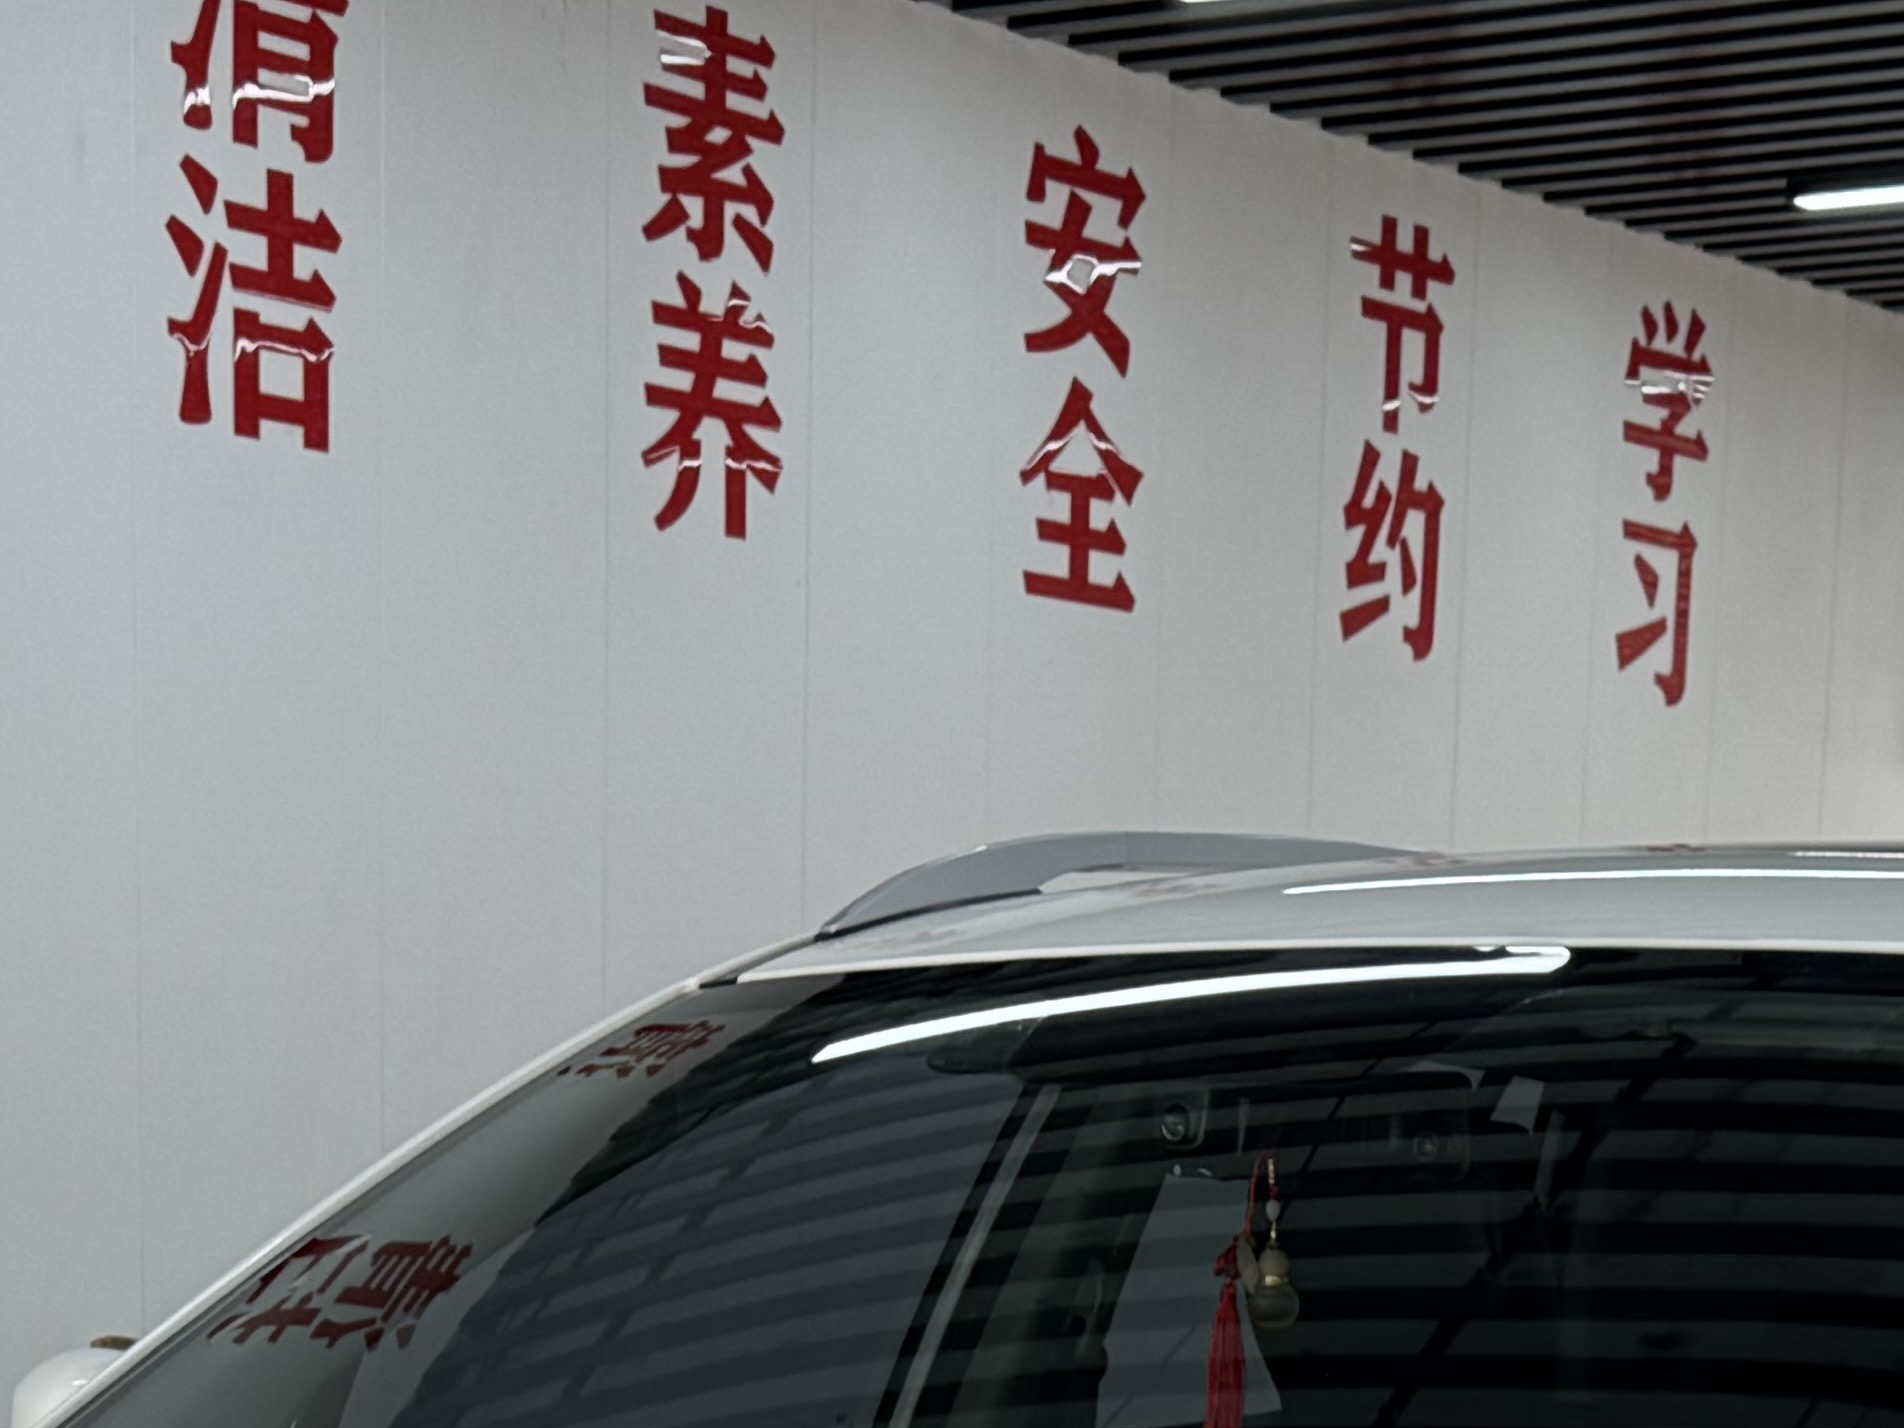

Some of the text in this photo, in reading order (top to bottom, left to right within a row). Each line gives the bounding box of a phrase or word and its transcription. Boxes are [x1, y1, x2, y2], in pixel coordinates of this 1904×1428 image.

[641, 5, 786, 541] 素养
[1019, 124, 1146, 613] 安全
[1339, 213, 1456, 662] 节约
[1615, 300, 1715, 708] 学习
